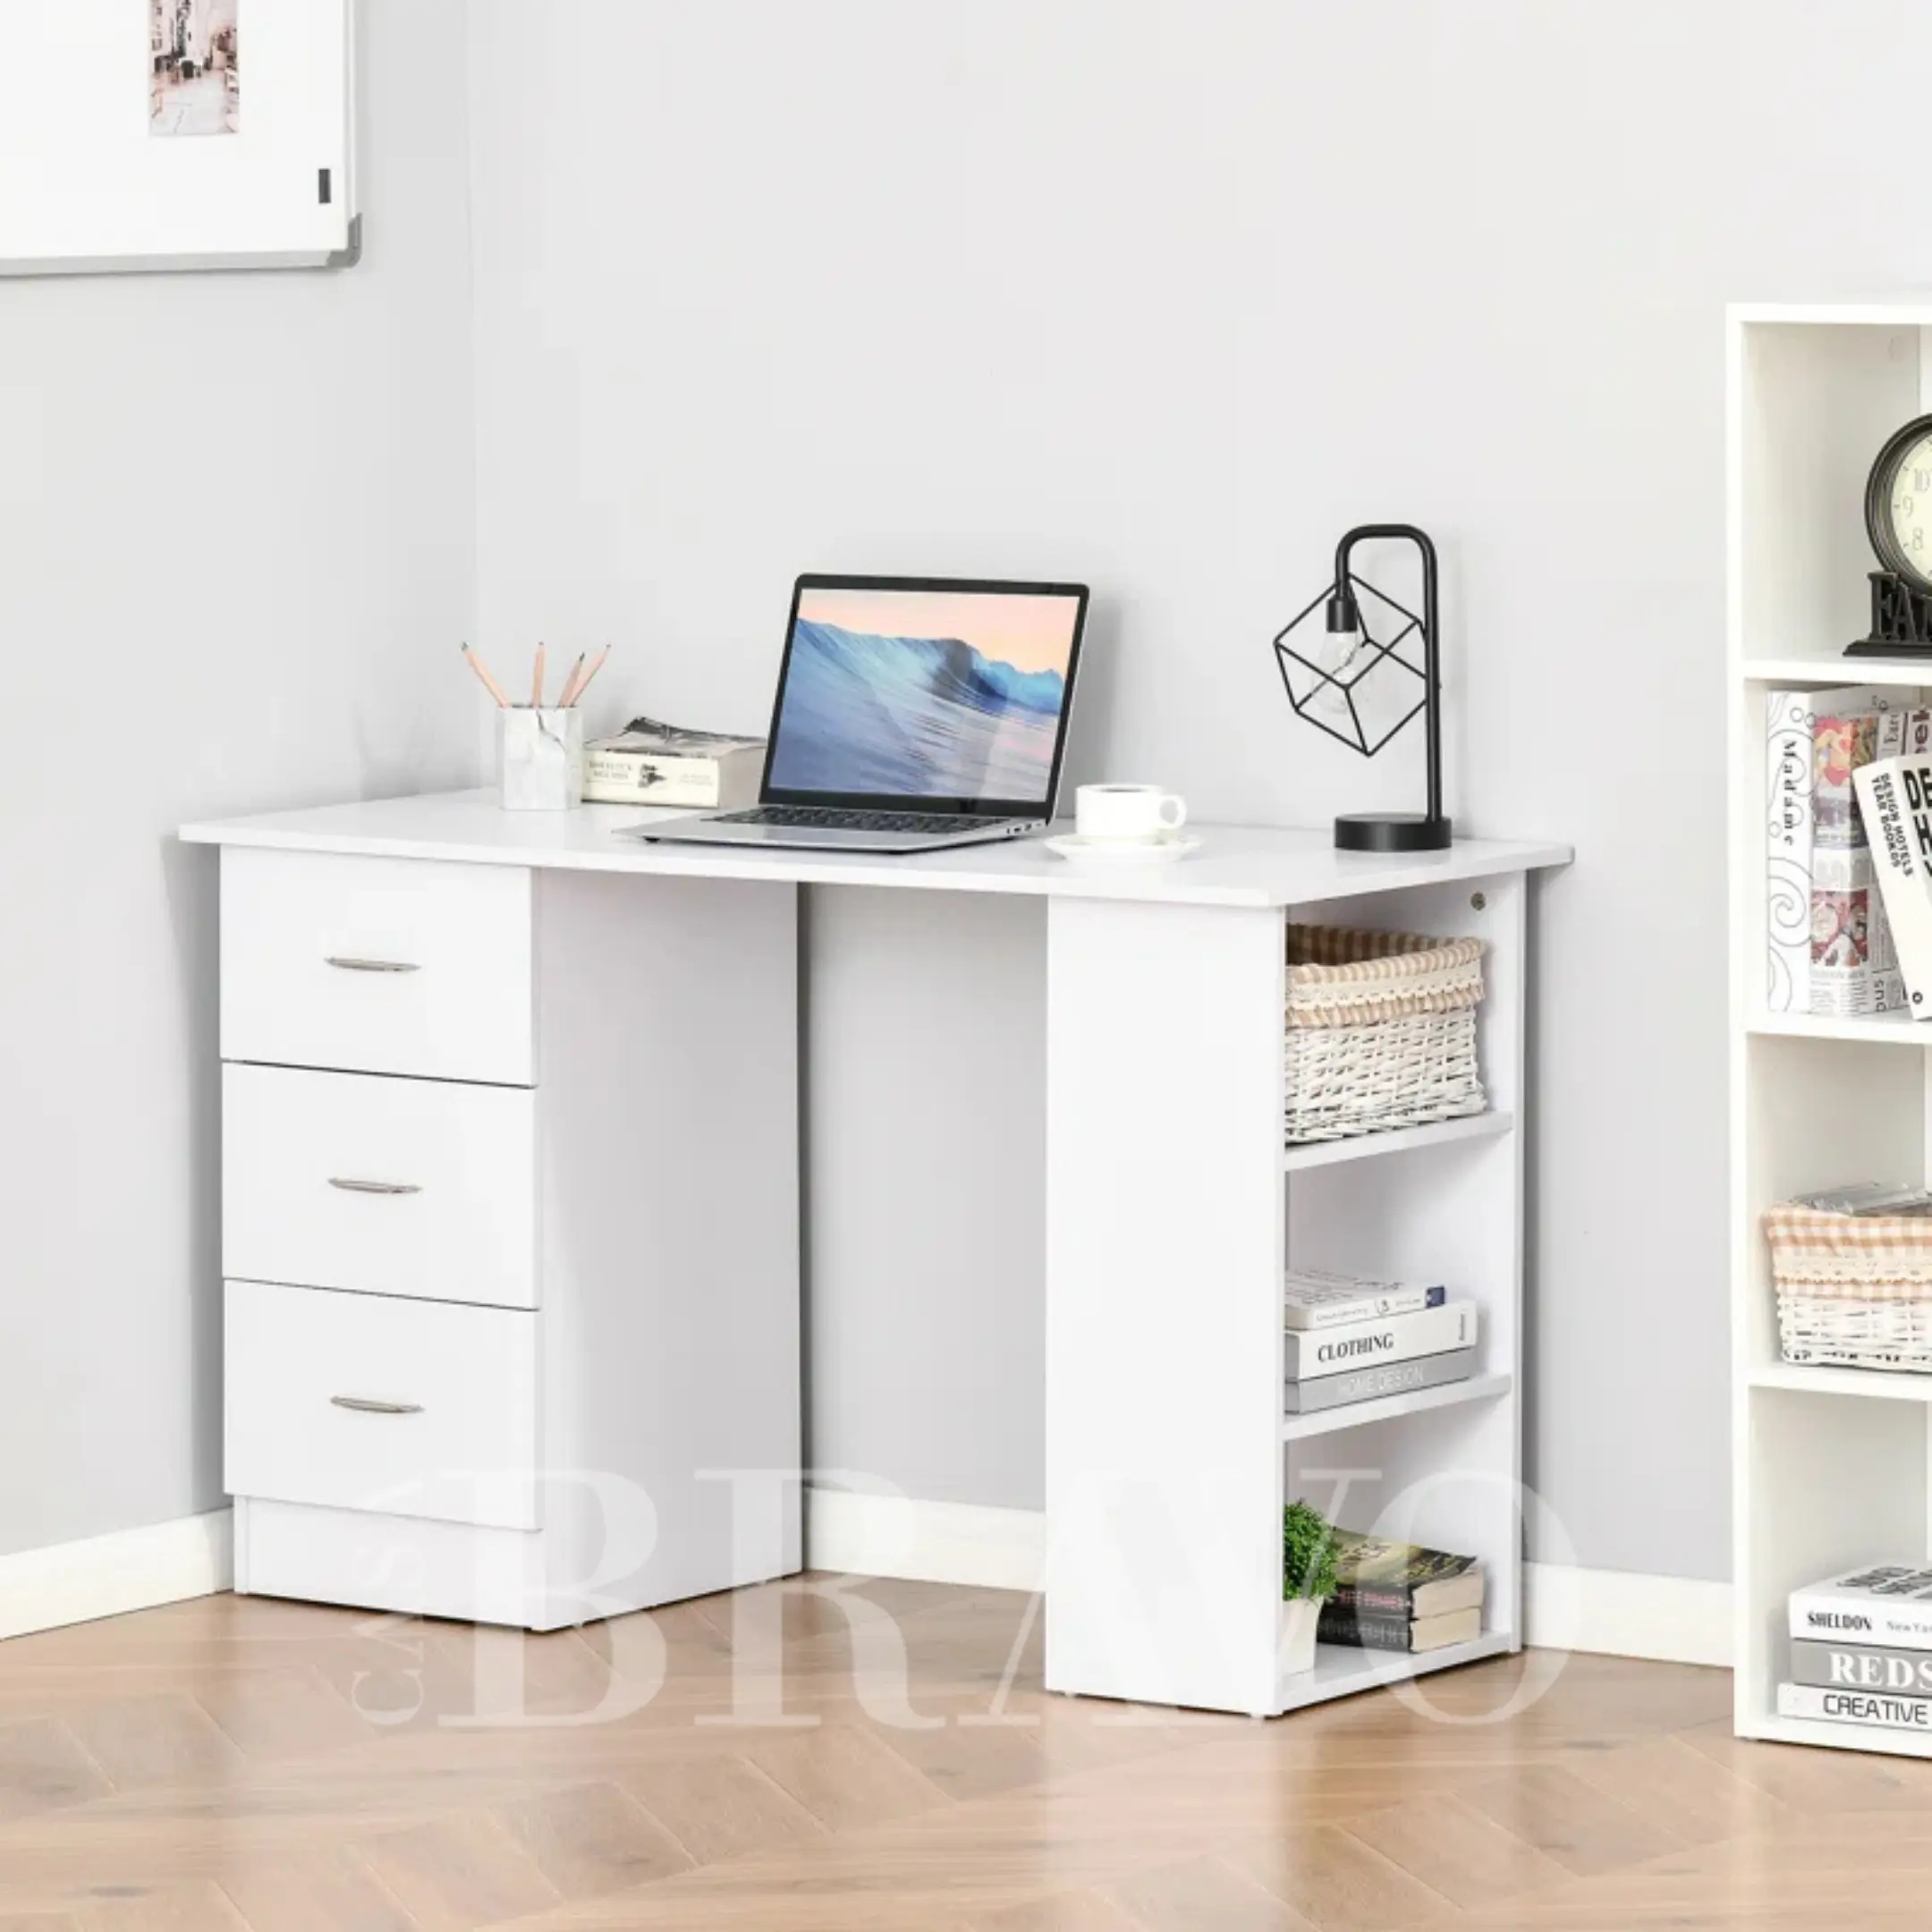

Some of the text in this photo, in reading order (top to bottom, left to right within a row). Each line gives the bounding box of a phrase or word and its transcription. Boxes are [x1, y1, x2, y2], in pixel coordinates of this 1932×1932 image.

[1902, 495, 1913, 518] 9
[1911, 527, 1924, 552] 8
[1784, 740, 1798, 846] Madame
[1871, 775, 1887, 811] YEAR
[1880, 772, 1914, 877] DESIGN HOTELS
[1318, 1332, 1394, 1363] CLOTHING
[1378, 1364, 1424, 1392] DESIGN
[1808, 1611, 1873, 1631] SHELDON
[1885, 1620, 1911, 1632] New
[1823, 1694, 1928, 1725] CREATIVE
